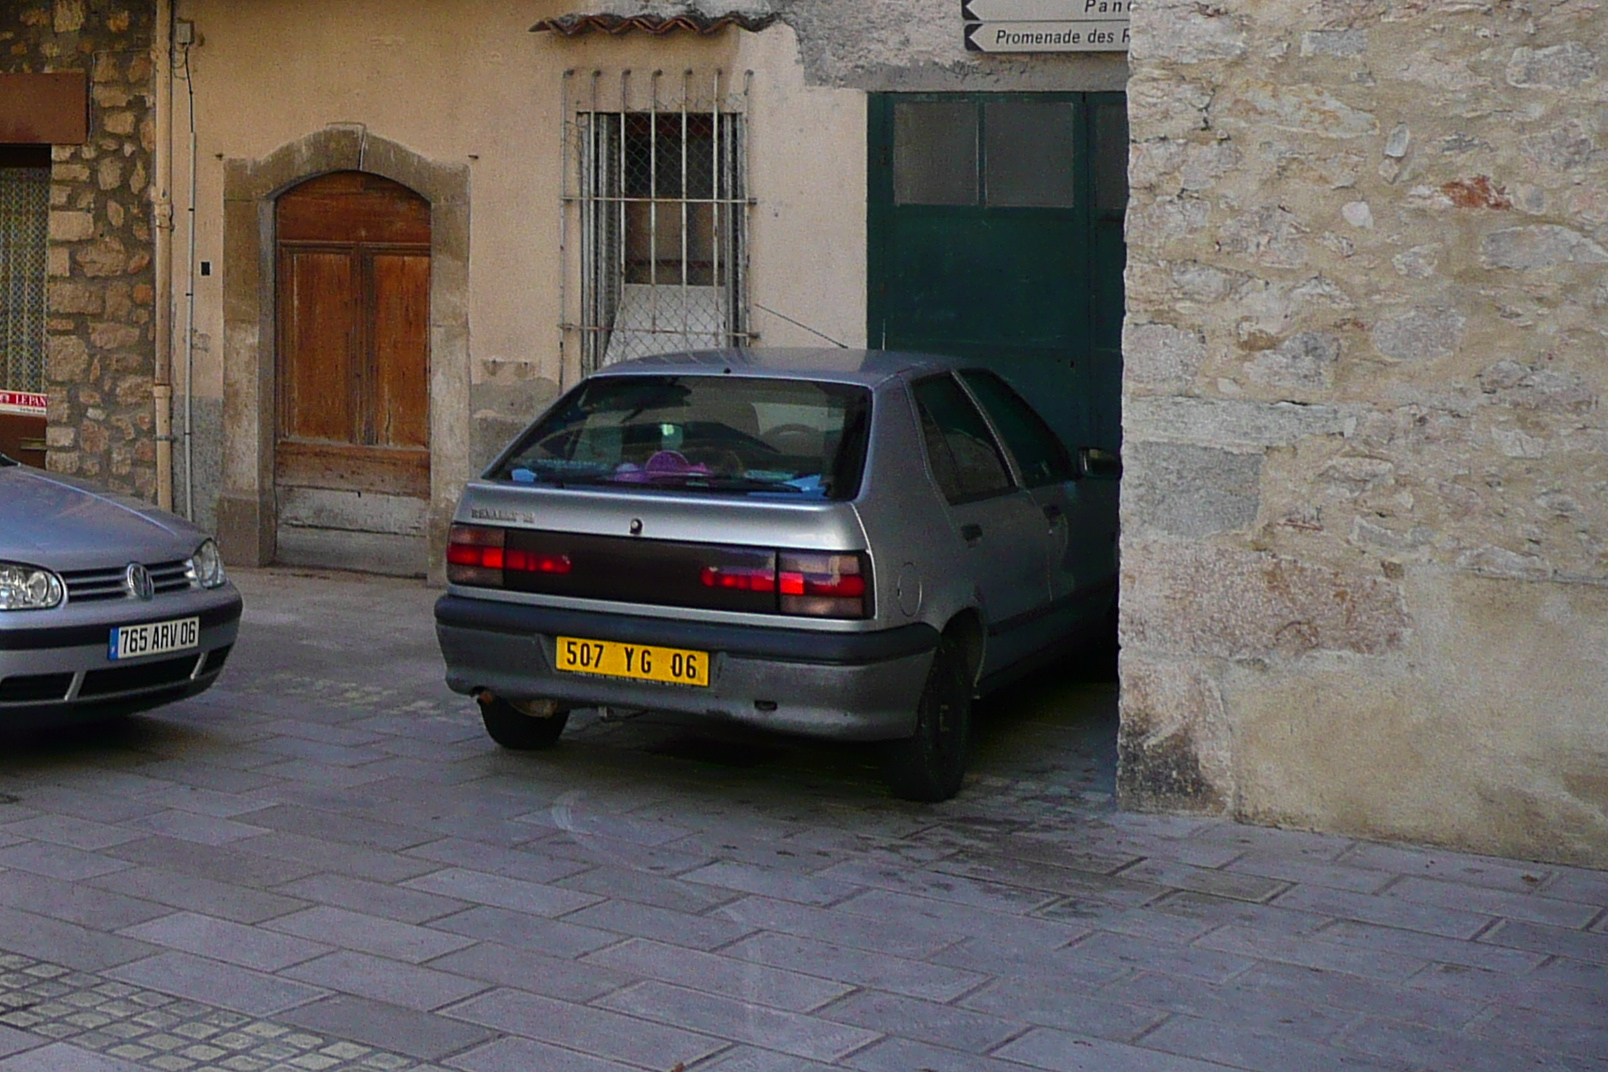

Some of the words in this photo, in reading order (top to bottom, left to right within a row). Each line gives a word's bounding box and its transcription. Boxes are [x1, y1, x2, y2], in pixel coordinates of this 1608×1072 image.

[996, 29, 1080, 44] Promenade
[1087, 28, 1114, 43] des
[120, 628, 148, 654] 765
[152, 623, 177, 650] ARV
[180, 621, 196, 645] 06
[567, 641, 604, 669] 507
[624, 646, 652, 674] YG
[671, 653, 697, 679] 06
